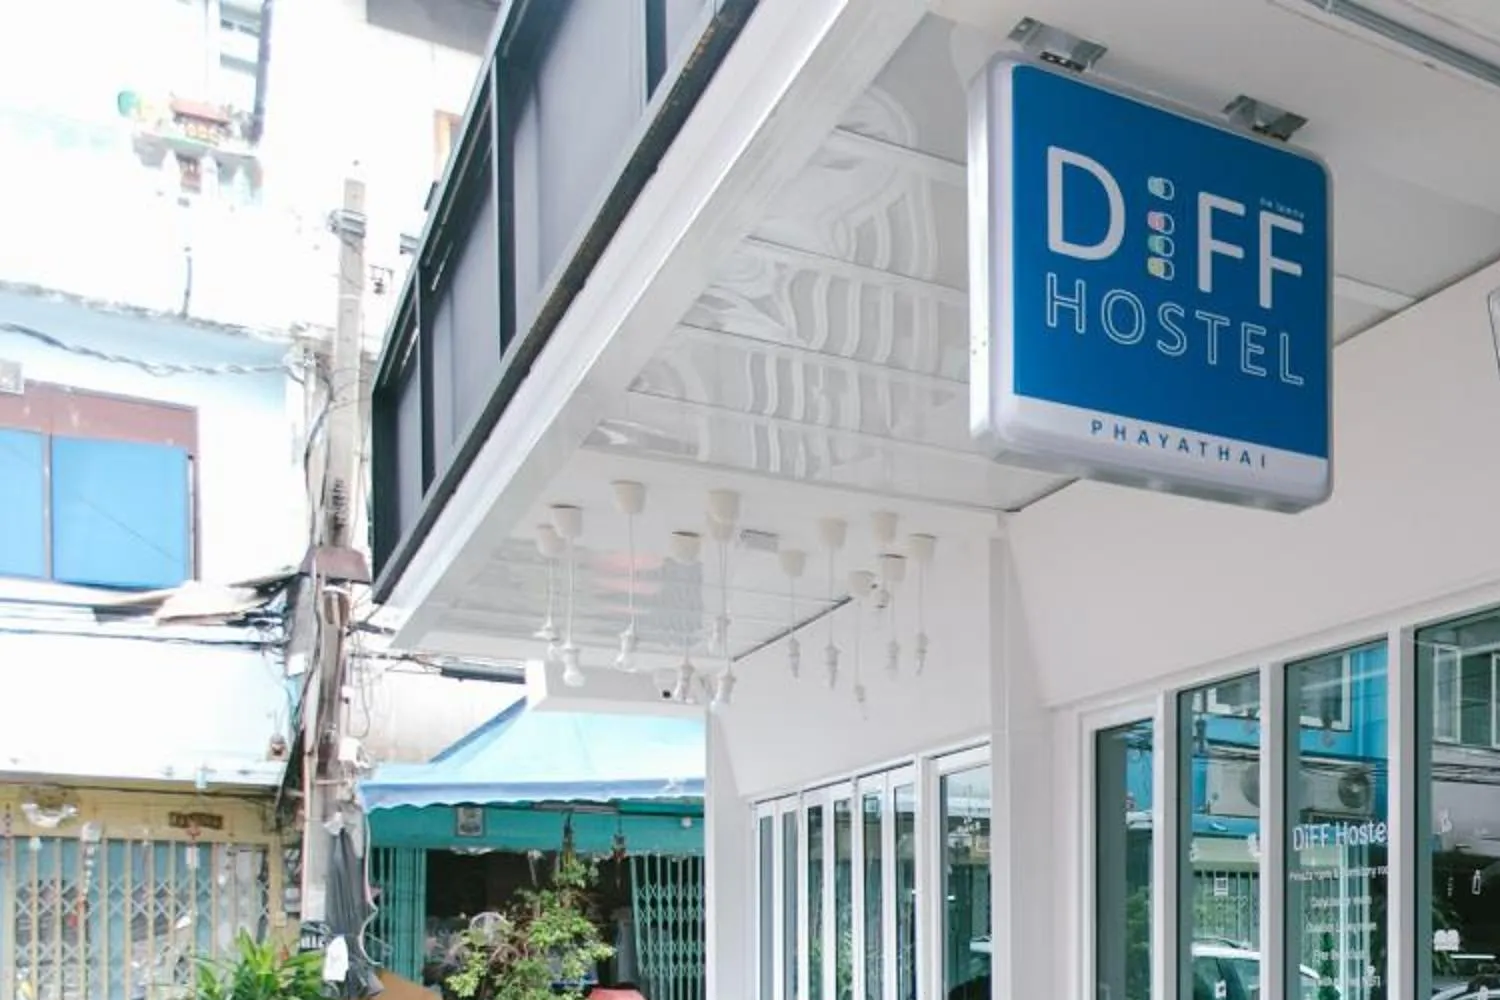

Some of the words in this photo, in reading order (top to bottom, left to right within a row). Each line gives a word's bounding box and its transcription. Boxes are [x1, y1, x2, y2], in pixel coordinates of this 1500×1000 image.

[1046, 272, 1304, 386] HOSTEL
[1091, 419, 1267, 469] PHAYATHAI
[1335, 819, 1387, 847] Hoste
